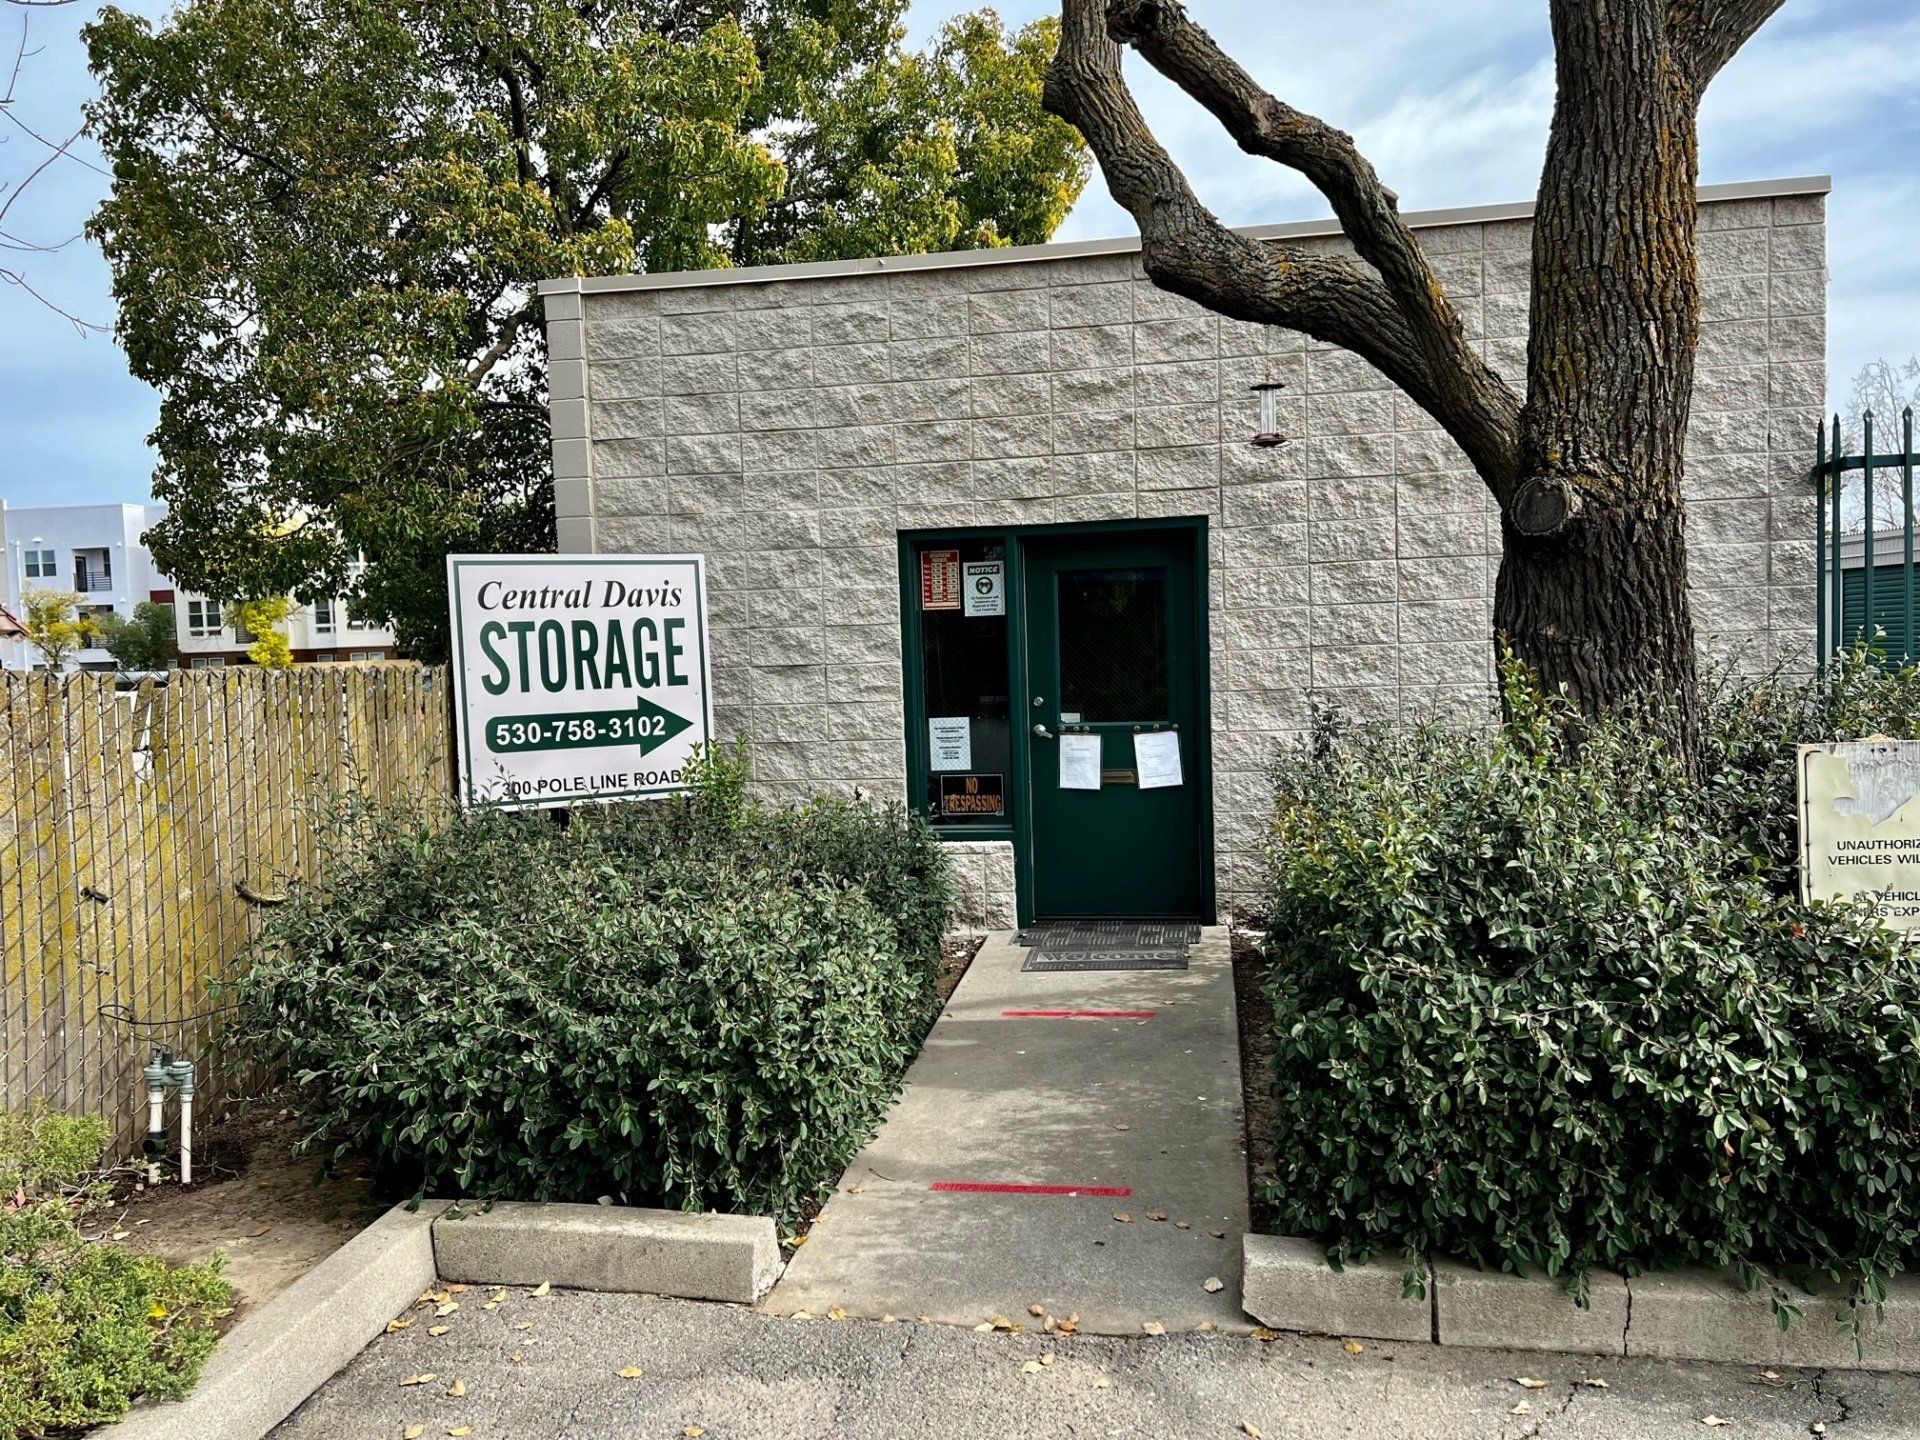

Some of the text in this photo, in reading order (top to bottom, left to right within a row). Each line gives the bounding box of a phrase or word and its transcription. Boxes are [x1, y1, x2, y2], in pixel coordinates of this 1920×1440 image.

[969, 566, 998, 574] NOTICE
[477, 580, 682, 610] Central Davis
[480, 617, 689, 695] STORAGE
[496, 715, 666, 745] 530-758-3102
[537, 776, 584, 793] POLE
[590, 773, 627, 790] LINE
[634, 769, 681, 786] ROAD
[965, 777, 978, 793] NO
[944, 794, 1001, 811] TRESPASSING
[1828, 855, 1892, 865] VEHICLES
[1036, 950, 1177, 962] Welcome
